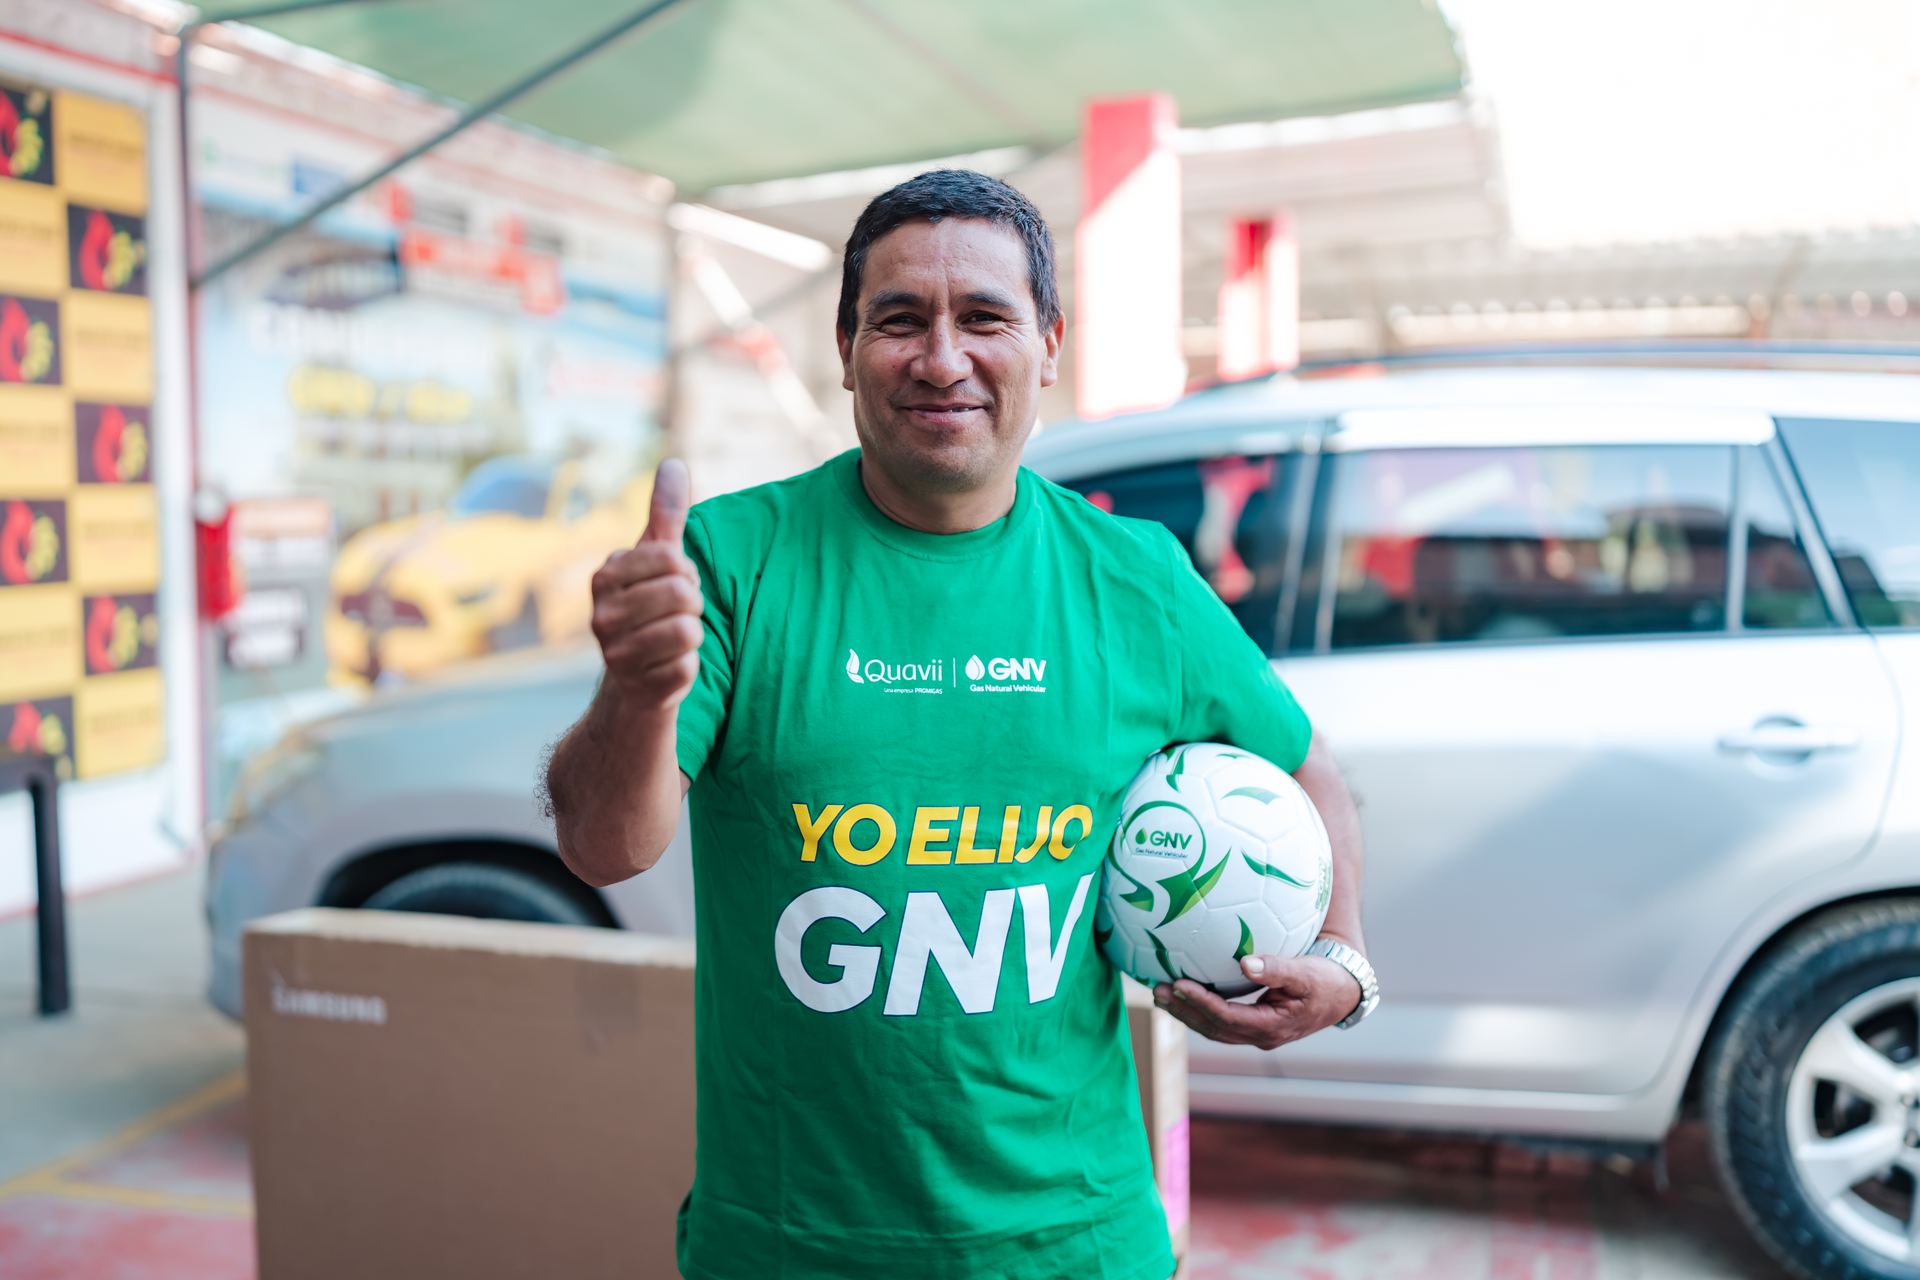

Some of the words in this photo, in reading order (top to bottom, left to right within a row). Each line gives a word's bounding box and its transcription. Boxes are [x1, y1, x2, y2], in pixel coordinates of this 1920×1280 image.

[864, 659, 943, 684] Quavii
[987, 657, 1047, 682] GNV
[969, 684, 985, 692] Gas
[985, 684, 1013, 692] Natural
[1012, 684, 1047, 693] Vehicular
[792, 803, 897, 866] YO
[905, 803, 1094, 865] ELIJO
[1150, 830, 1193, 850] GNV
[774, 871, 1096, 1016] GNV
